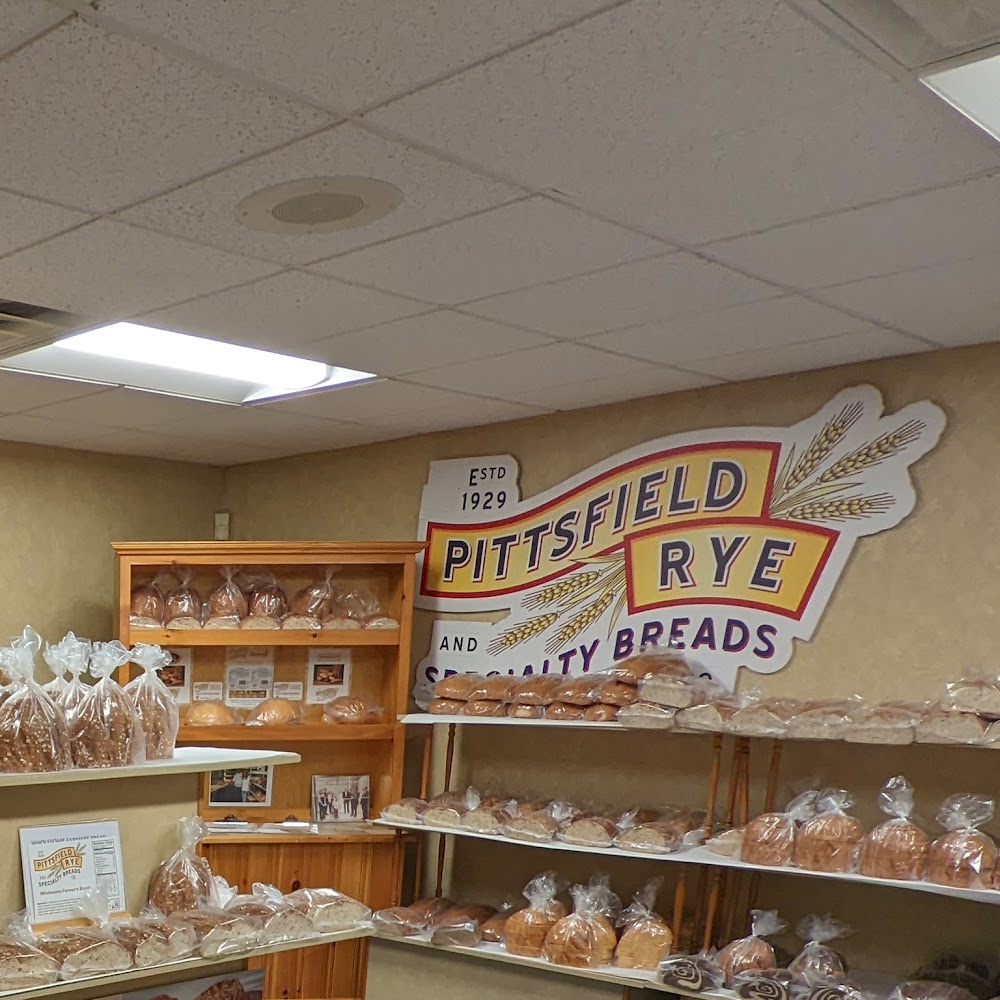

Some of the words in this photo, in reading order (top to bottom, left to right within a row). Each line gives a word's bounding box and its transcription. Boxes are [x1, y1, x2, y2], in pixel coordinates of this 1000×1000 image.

[469, 467, 506, 487] ESTD
[462, 491, 507, 510] 1929
[443, 460, 748, 582] PITTSFIELD
[659, 535, 794, 592] RYE
[440, 636, 477, 651] AND
[612, 616, 778, 662] BREADS
[37, 849, 73, 868] PITTSFIELD
[65, 858, 78, 866] RYE
[39, 875, 62, 887] SPECIALTY
[63, 868, 81, 877] BREADS
